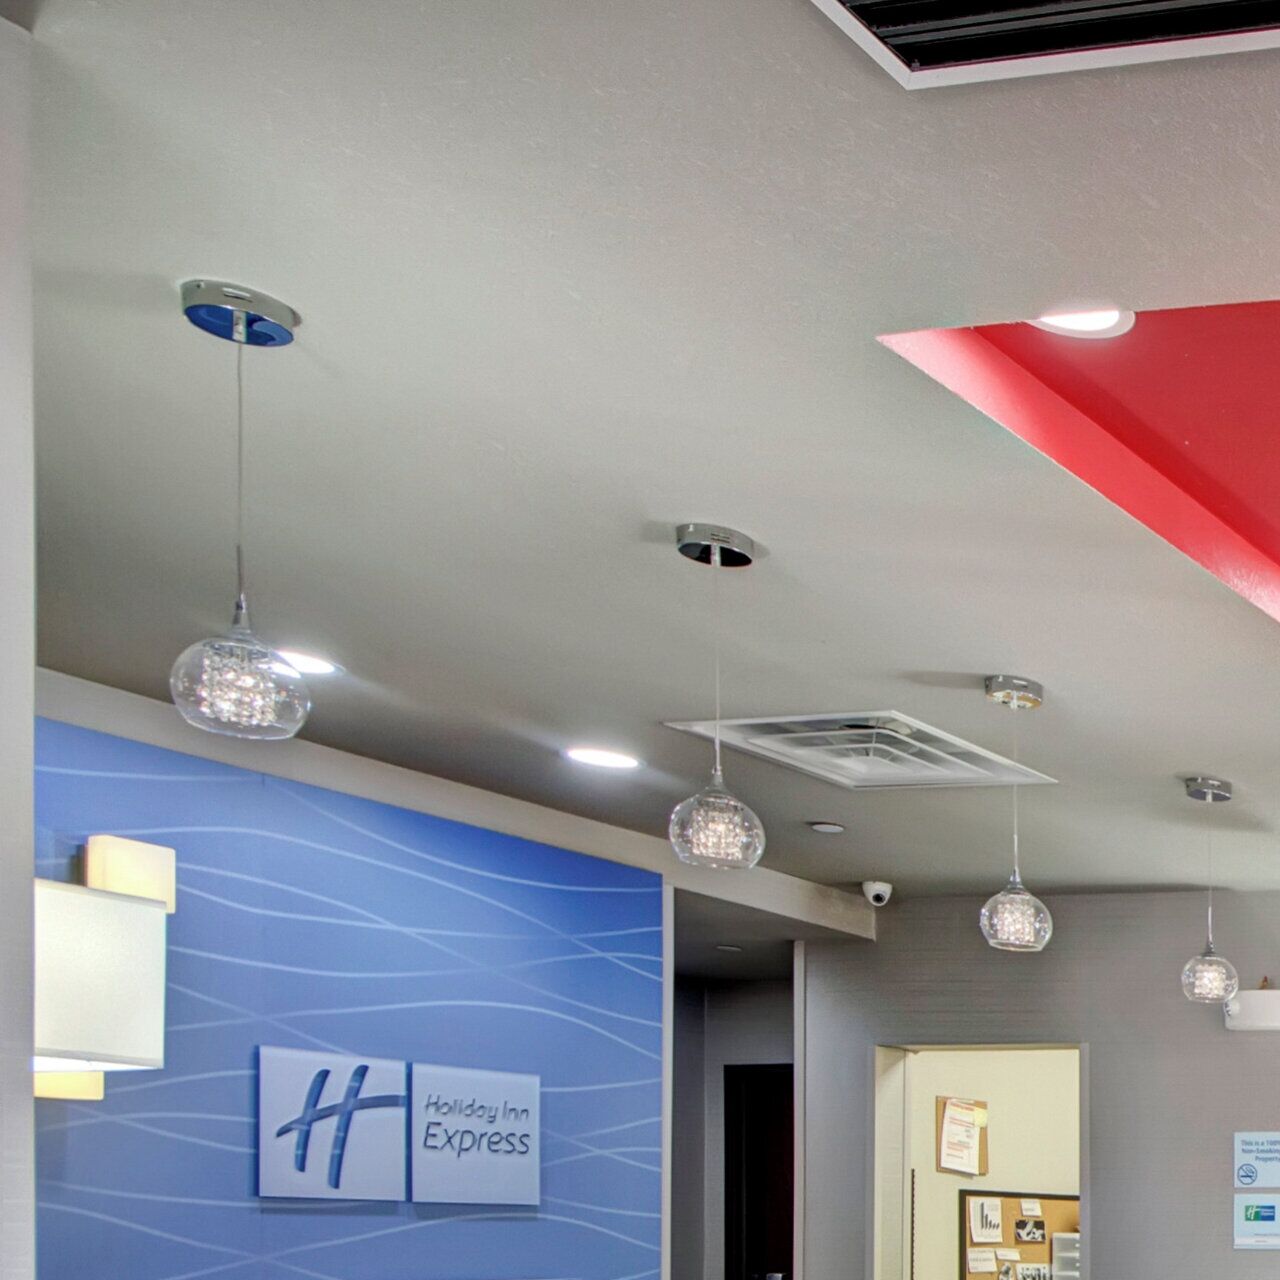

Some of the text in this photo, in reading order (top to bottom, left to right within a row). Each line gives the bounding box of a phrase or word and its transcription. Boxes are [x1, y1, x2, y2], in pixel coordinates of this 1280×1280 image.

[424, 1094, 530, 1123] Holiday Inn
[423, 1121, 531, 1158] Express
